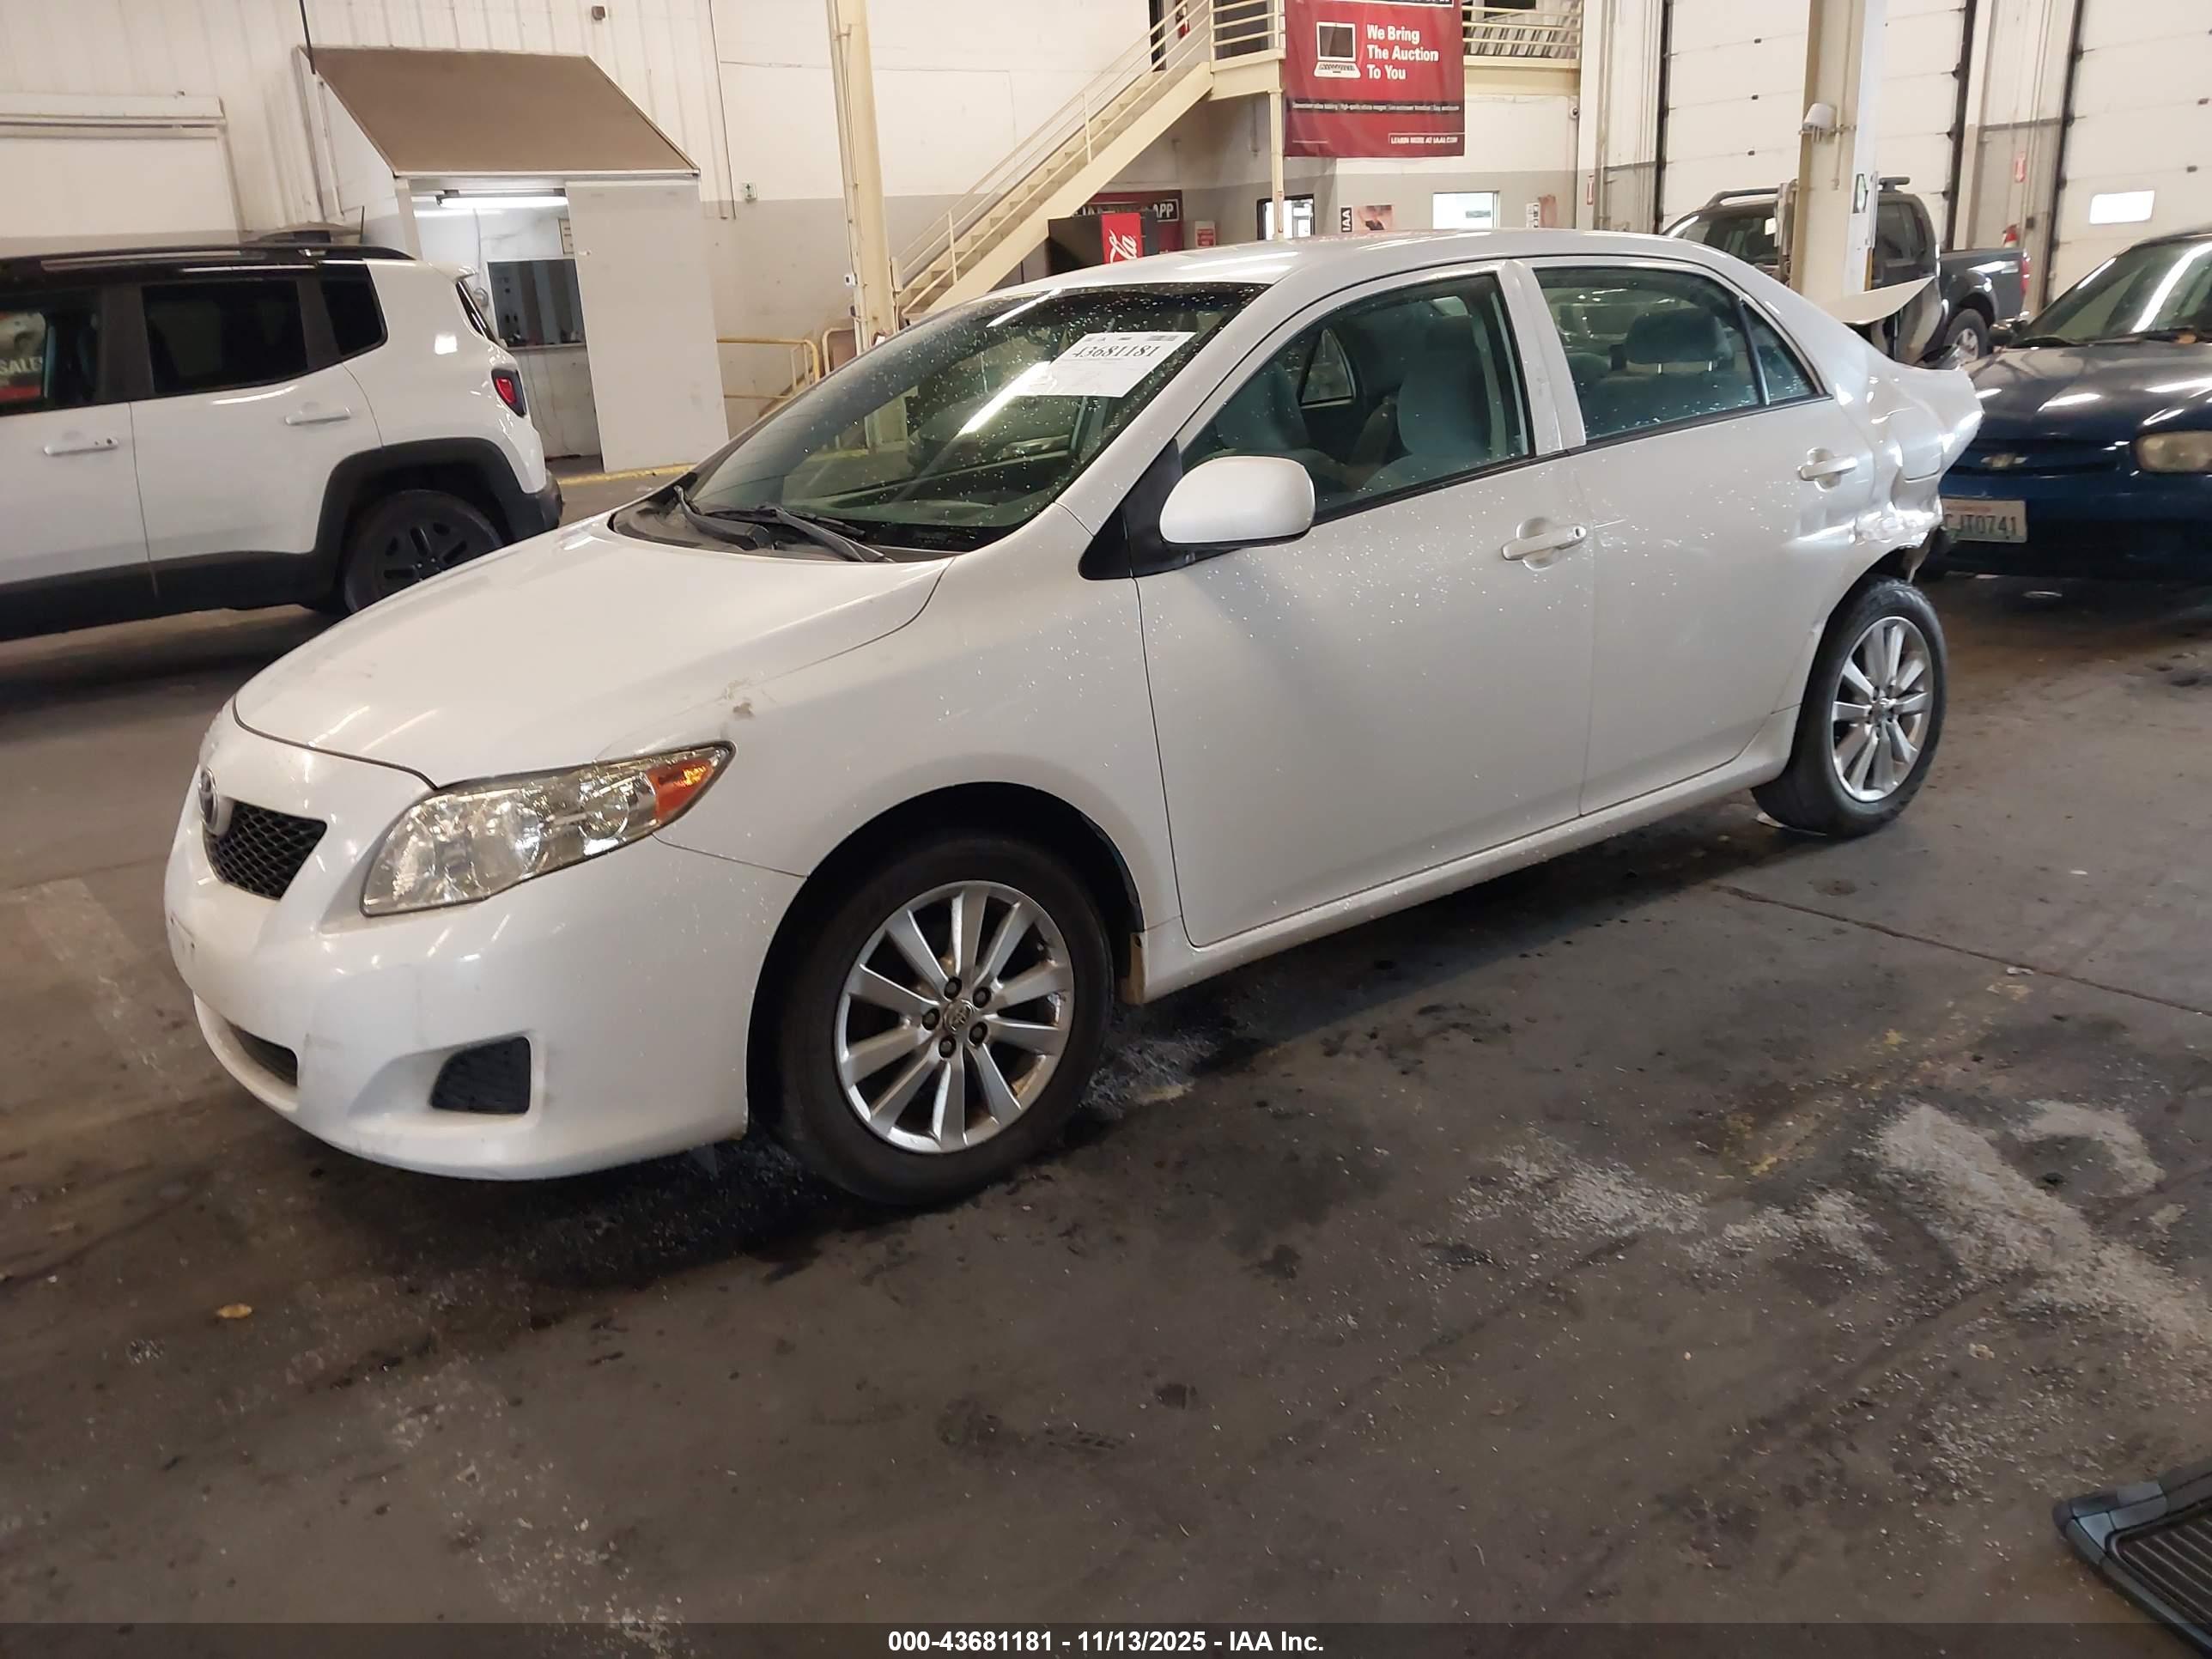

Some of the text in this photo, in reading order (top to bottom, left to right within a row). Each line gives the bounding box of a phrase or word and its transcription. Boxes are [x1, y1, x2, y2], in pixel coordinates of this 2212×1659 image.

[1366, 24, 1420, 45] We Bring
[1366, 45, 1439, 62] The Auction
[1366, 64, 1407, 80] To You
[1342, 210, 1352, 231] IAA
